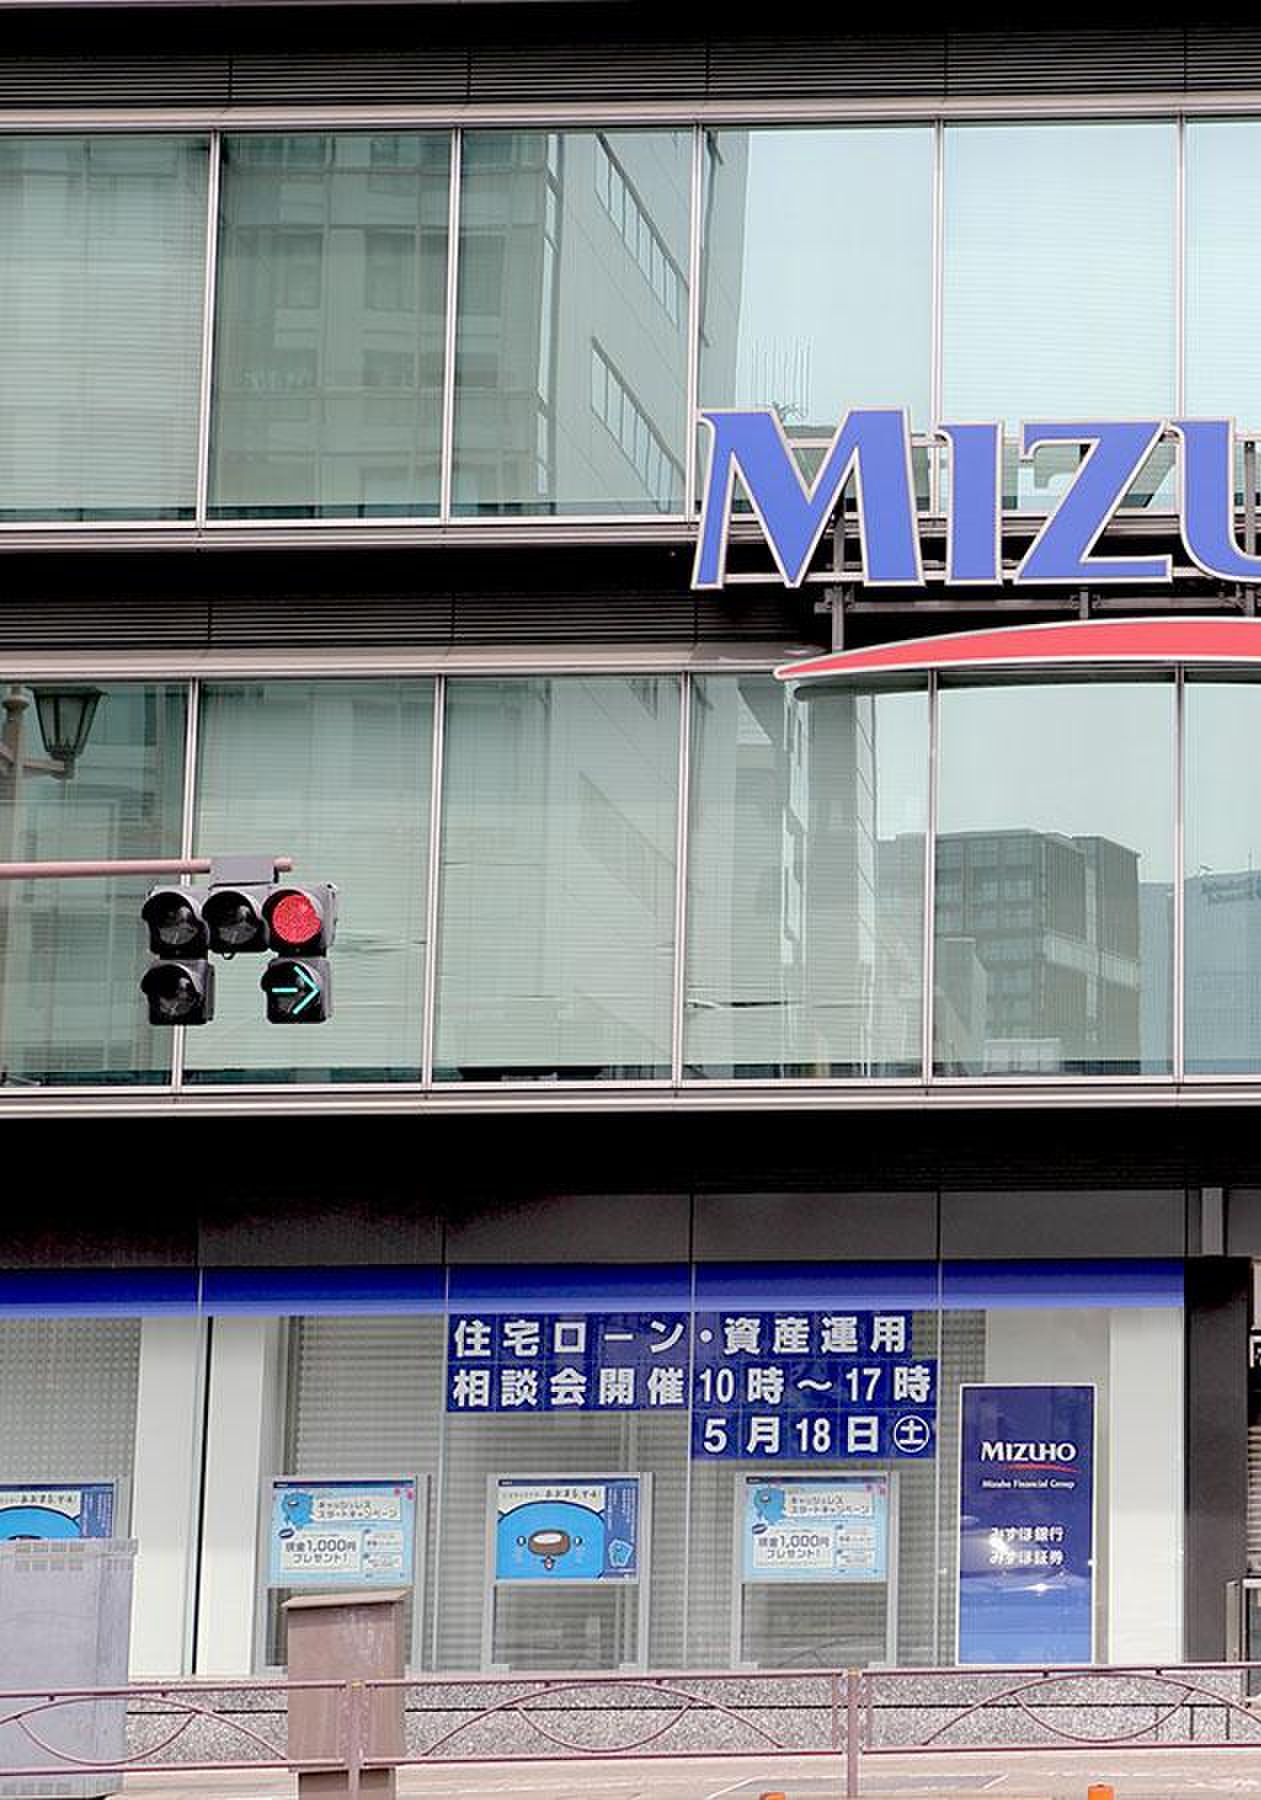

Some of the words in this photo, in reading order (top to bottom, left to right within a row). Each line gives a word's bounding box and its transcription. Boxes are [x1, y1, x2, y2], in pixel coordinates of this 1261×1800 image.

[454, 1316, 906, 1359] 住宅ローン・資産運用
[981, 1441, 1076, 1461] MIZUHO
[982, 1480, 1011, 1488] Mizuho
[990, 1526, 1063, 1542] みずほ銀行
